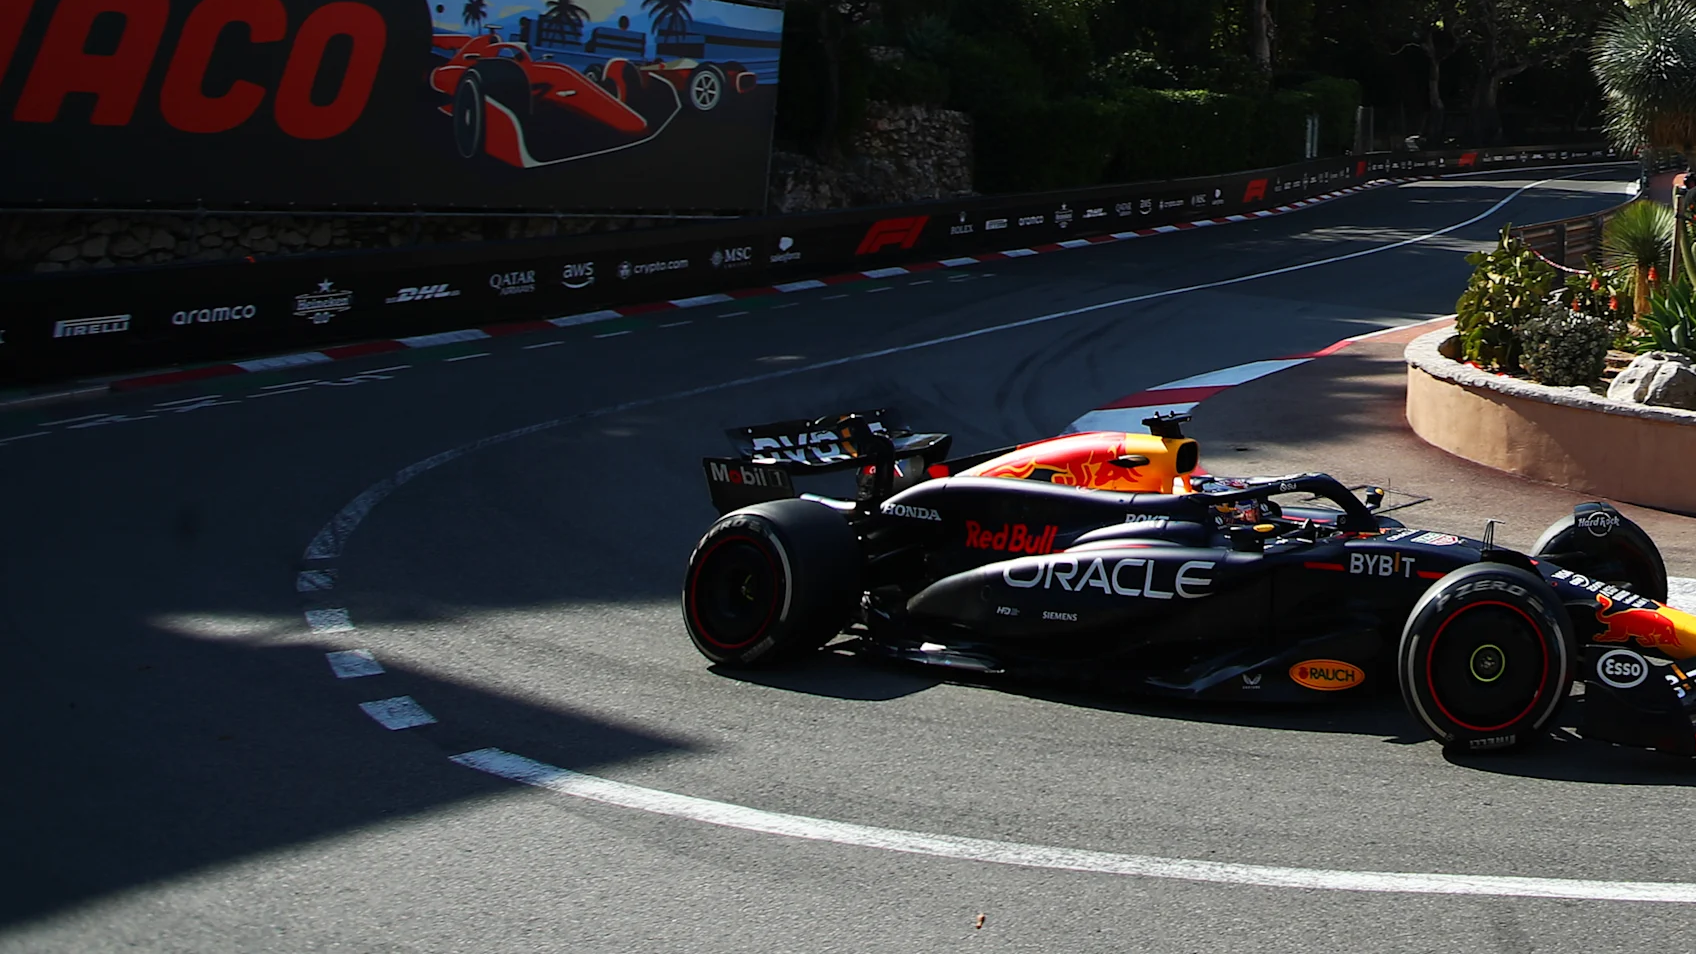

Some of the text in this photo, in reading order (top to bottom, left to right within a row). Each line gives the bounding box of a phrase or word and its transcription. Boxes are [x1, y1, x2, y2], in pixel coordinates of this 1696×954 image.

[724, 247, 753, 263] MSC
[562, 262, 595, 279] aws
[634, 258, 690, 275] crypto.com
[489, 270, 537, 290] QATAR
[393, 283, 452, 304] DHL
[172, 304, 256, 325] aramco
[53, 313, 132, 338] PIRELLI
[711, 461, 769, 487] Mobil
[881, 504, 942, 522] HONDA
[1578, 515, 1621, 529] Hard Rock
[965, 520, 1059, 555] Red Bull
[1349, 552, 1415, 578] BYBIT
[1003, 557, 1217, 600] ORACLE
[1454, 579, 1529, 600] ZERO
[1041, 610, 1078, 622] SIEMENS
[1309, 667, 1355, 682] RAUCH
[1605, 659, 1641, 677] Esso
